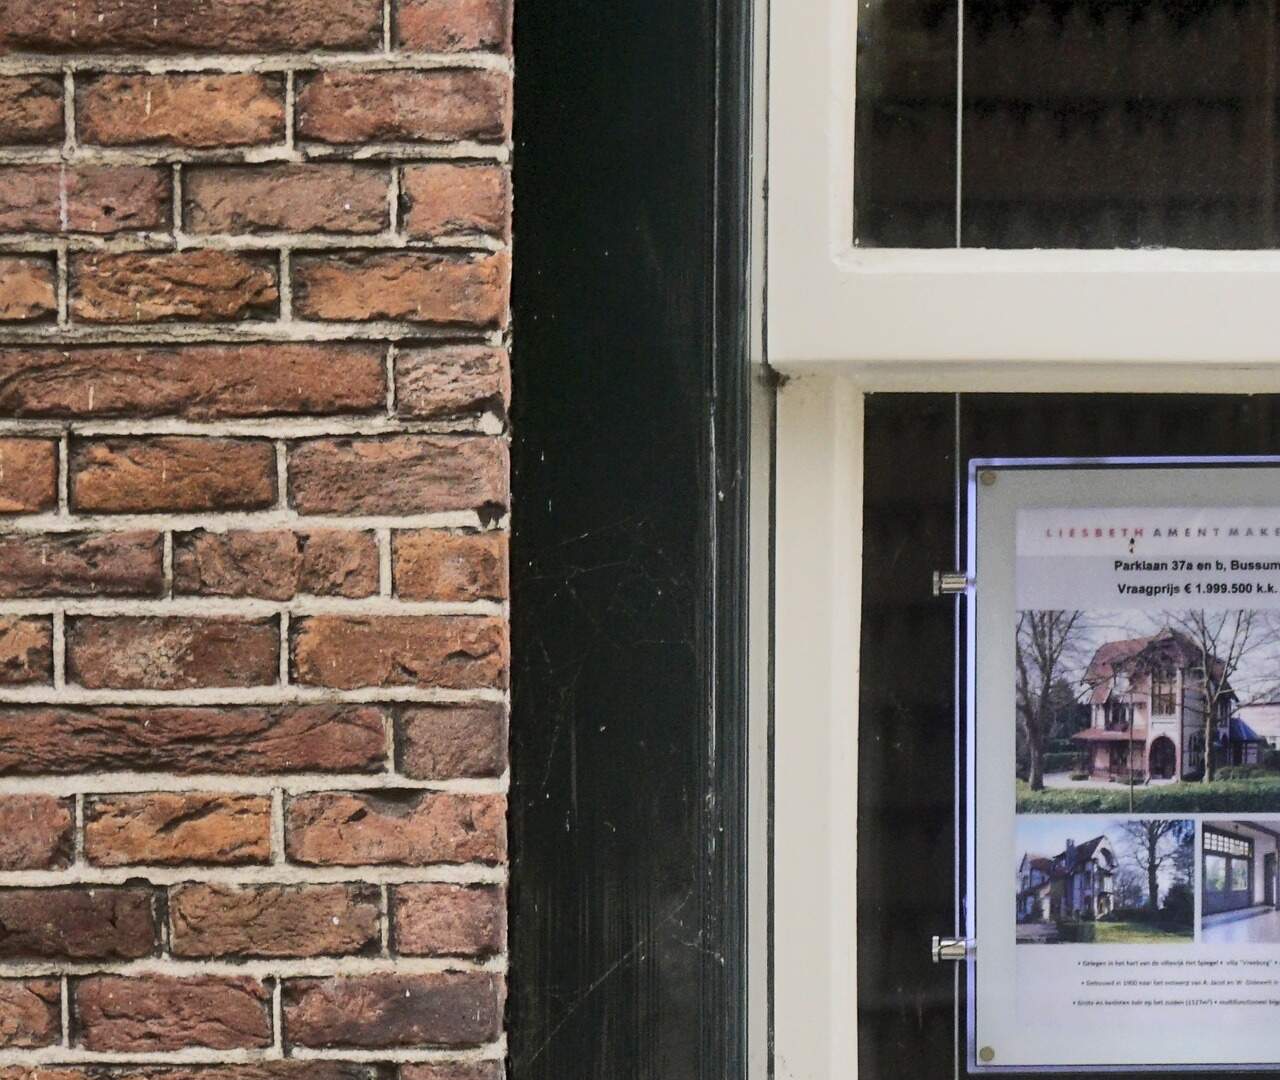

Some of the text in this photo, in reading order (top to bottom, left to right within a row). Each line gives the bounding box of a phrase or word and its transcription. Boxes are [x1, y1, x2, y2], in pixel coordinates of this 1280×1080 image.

[1046, 528, 1144, 538] LIESBETH
[1152, 527, 1220, 538] AMENT
[1114, 560, 1168, 572] Parklaan
[1171, 560, 1194, 571] 37a
[1196, 562, 1212, 571] en
[1215, 560, 1227, 573] b,
[1117, 583, 1278, 596] Vraagprijs € 1.999.500 k.k.
